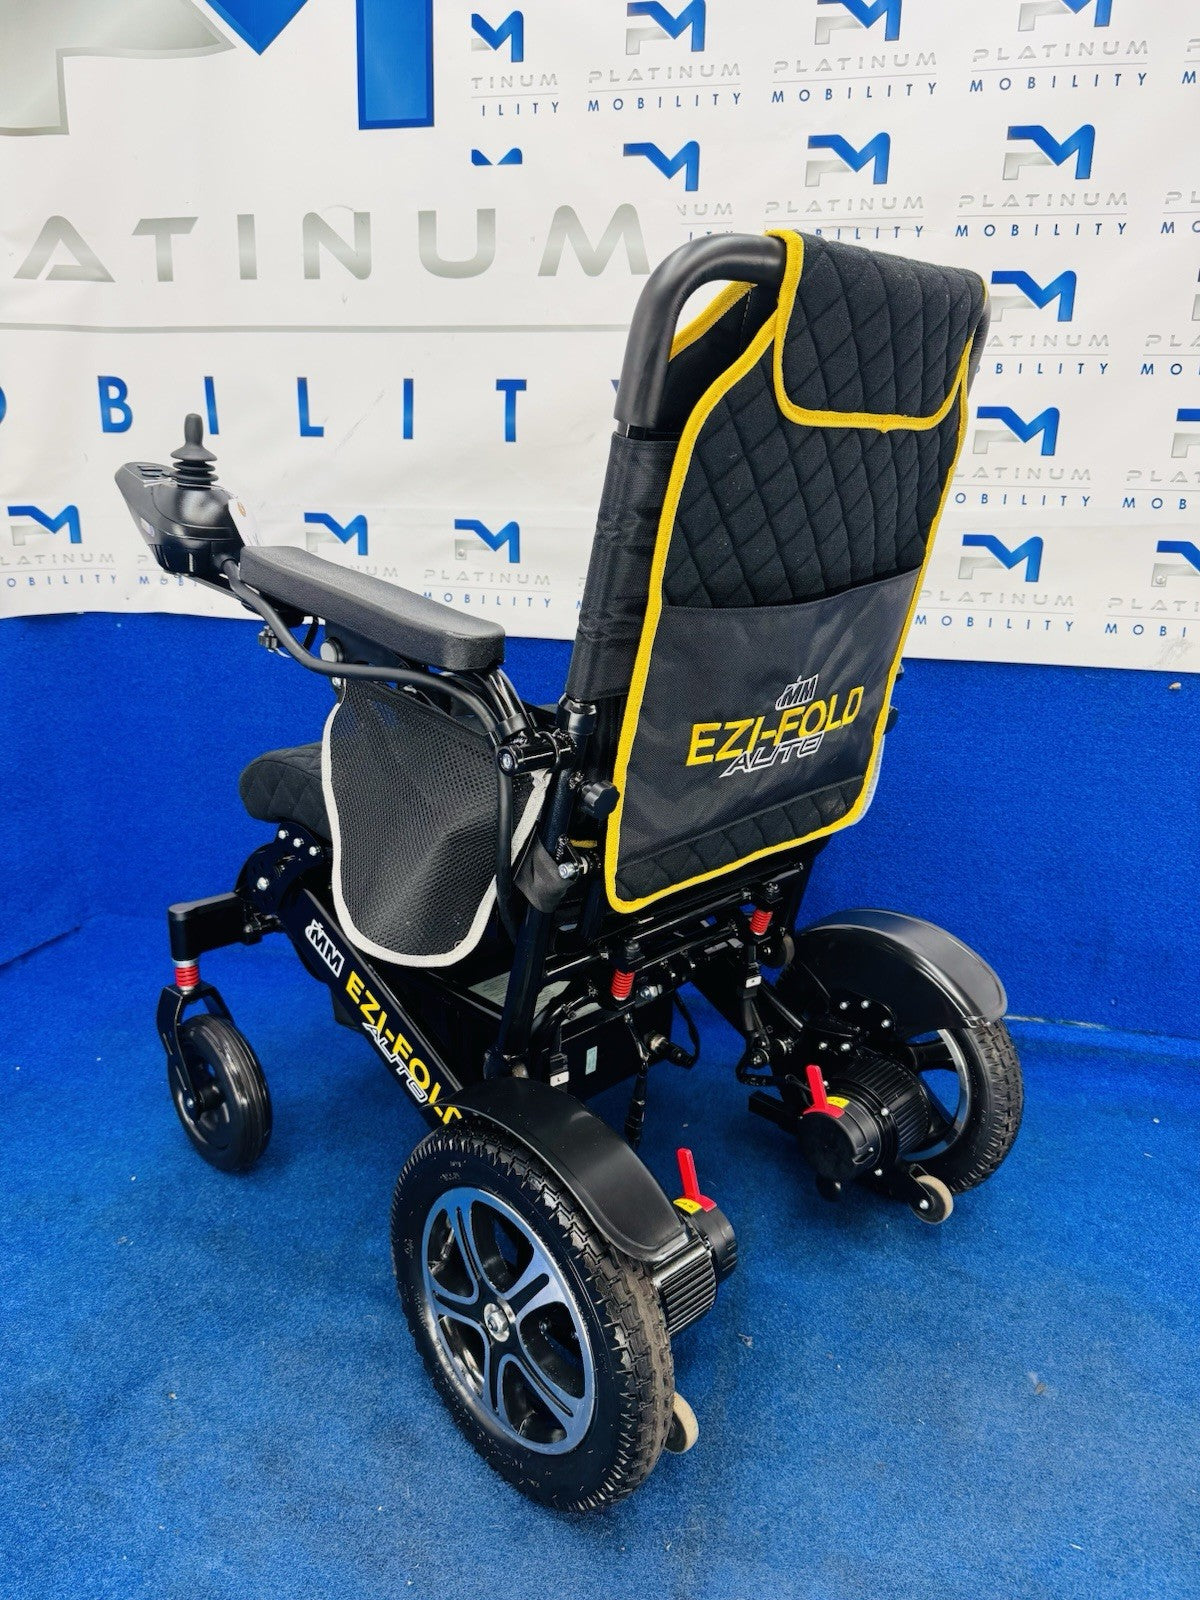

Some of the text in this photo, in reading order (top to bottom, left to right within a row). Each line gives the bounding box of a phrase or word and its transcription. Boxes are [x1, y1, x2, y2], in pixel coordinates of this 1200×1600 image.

[972, 40, 1148, 62] PLATINUM
[774, 52, 937, 74] PLATINUM
[588, 62, 741, 84] PLATINUM
[969, 72, 1147, 92] MOBILITY
[588, 92, 741, 112] MOBILITY
[772, 83, 937, 103] MOBILITY
[482, 101, 560, 116] ILITY
[765, 196, 924, 215] PLATINUM
[958, 192, 1128, 208] PLATINUM
[815, 225, 924, 241] BILITY
[955, 222, 1127, 237] MOBILITY
[13, 203, 651, 283] ATINUM
[986, 334, 1109, 347] ATINUM
[995, 363, 1109, 375] BILITY
[0, 375, 622, 442] BILIT
[955, 493, 1091, 507] OBILITY
[424, 569, 549, 585] PLATINUM
[423, 592, 550, 608] MOBILITY
[921, 590, 1074, 607] PLATINUM
[914, 615, 1074, 631] MOBILITY
[685, 685, 864, 767] EZI-FOLD
[719, 730, 825, 778] AUTO
[362, 1022, 429, 1103] AUTO
